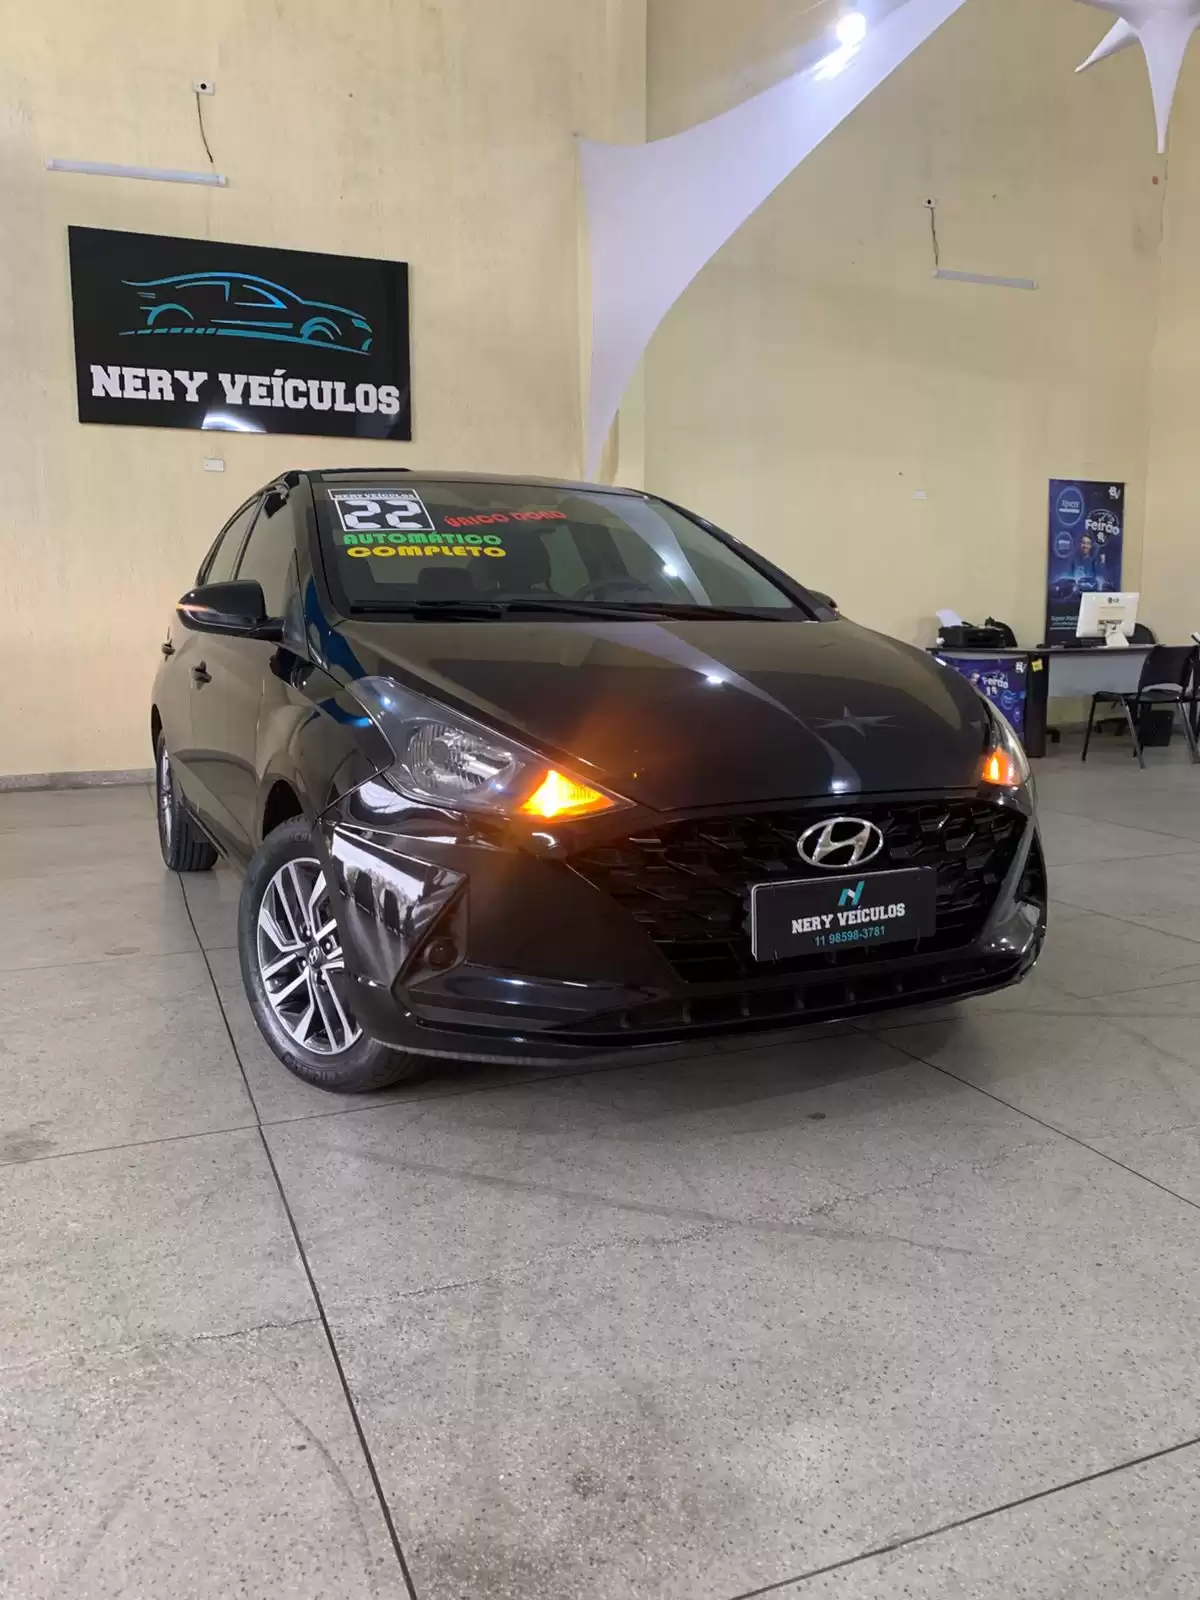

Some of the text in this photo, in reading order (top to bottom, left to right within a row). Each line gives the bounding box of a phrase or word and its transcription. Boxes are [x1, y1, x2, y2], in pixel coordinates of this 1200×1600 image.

[90, 365, 400, 414] NERY VEÍCULOS
[344, 500, 423, 528] 22
[1085, 518, 1120, 535] Feirão
[343, 531, 502, 545] AUTOMÁTICO
[347, 546, 506, 558] COMPLETO
[791, 903, 906, 934] NERY VEÍCULOS
[815, 926, 886, 947] 11 98598-3781
